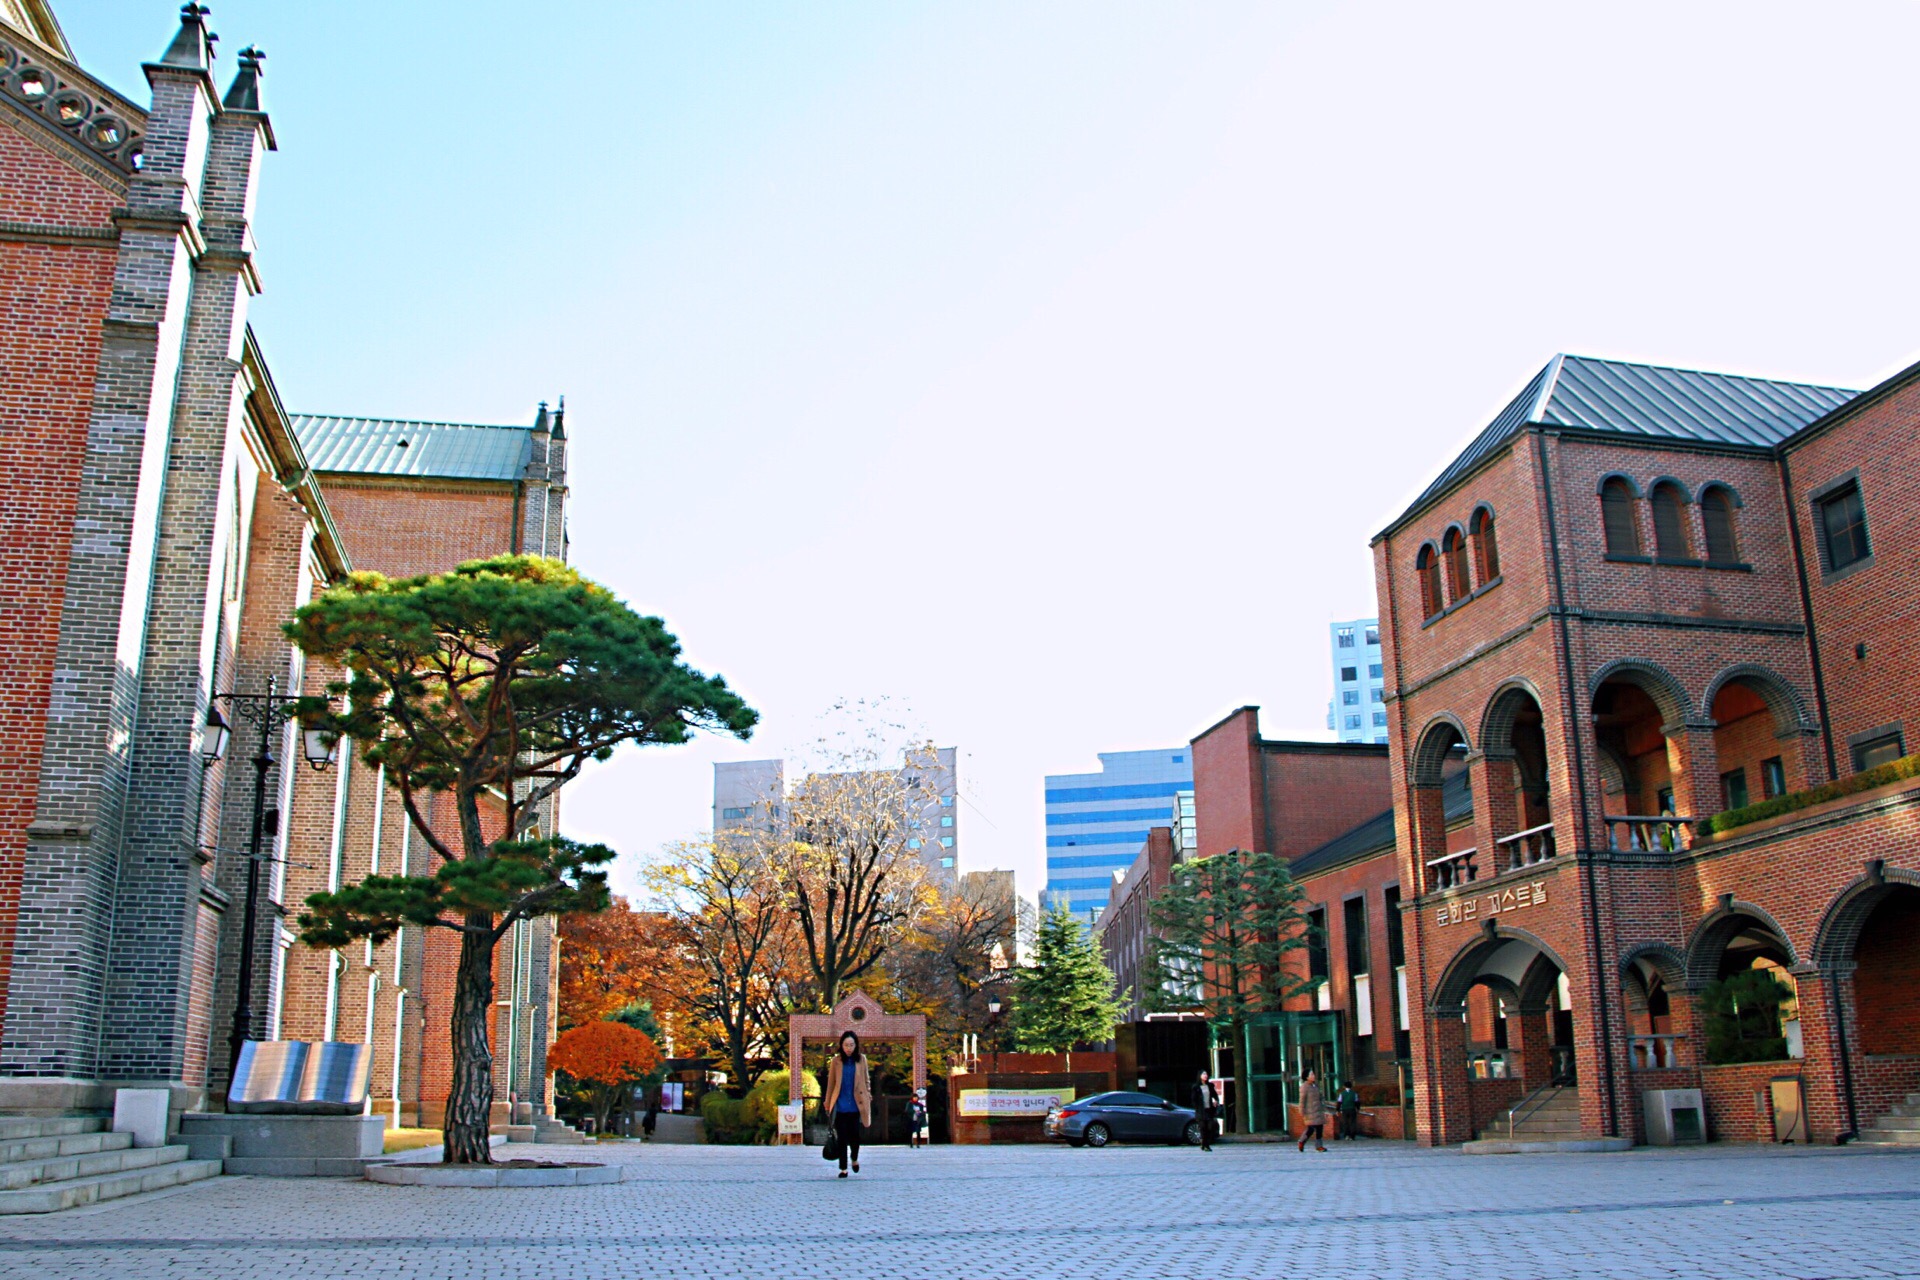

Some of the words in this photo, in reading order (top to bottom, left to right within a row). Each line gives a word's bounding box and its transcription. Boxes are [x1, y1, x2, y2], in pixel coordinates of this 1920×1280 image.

[1436, 900, 1478, 927] 문화관
[1487, 881, 1547, 915] 꼬스트홀
[968, 1099, 987, 1108] 이곳은
[990, 1099, 1020, 1108] 금연구역
[1023, 1099, 1045, 1108] 입니다
